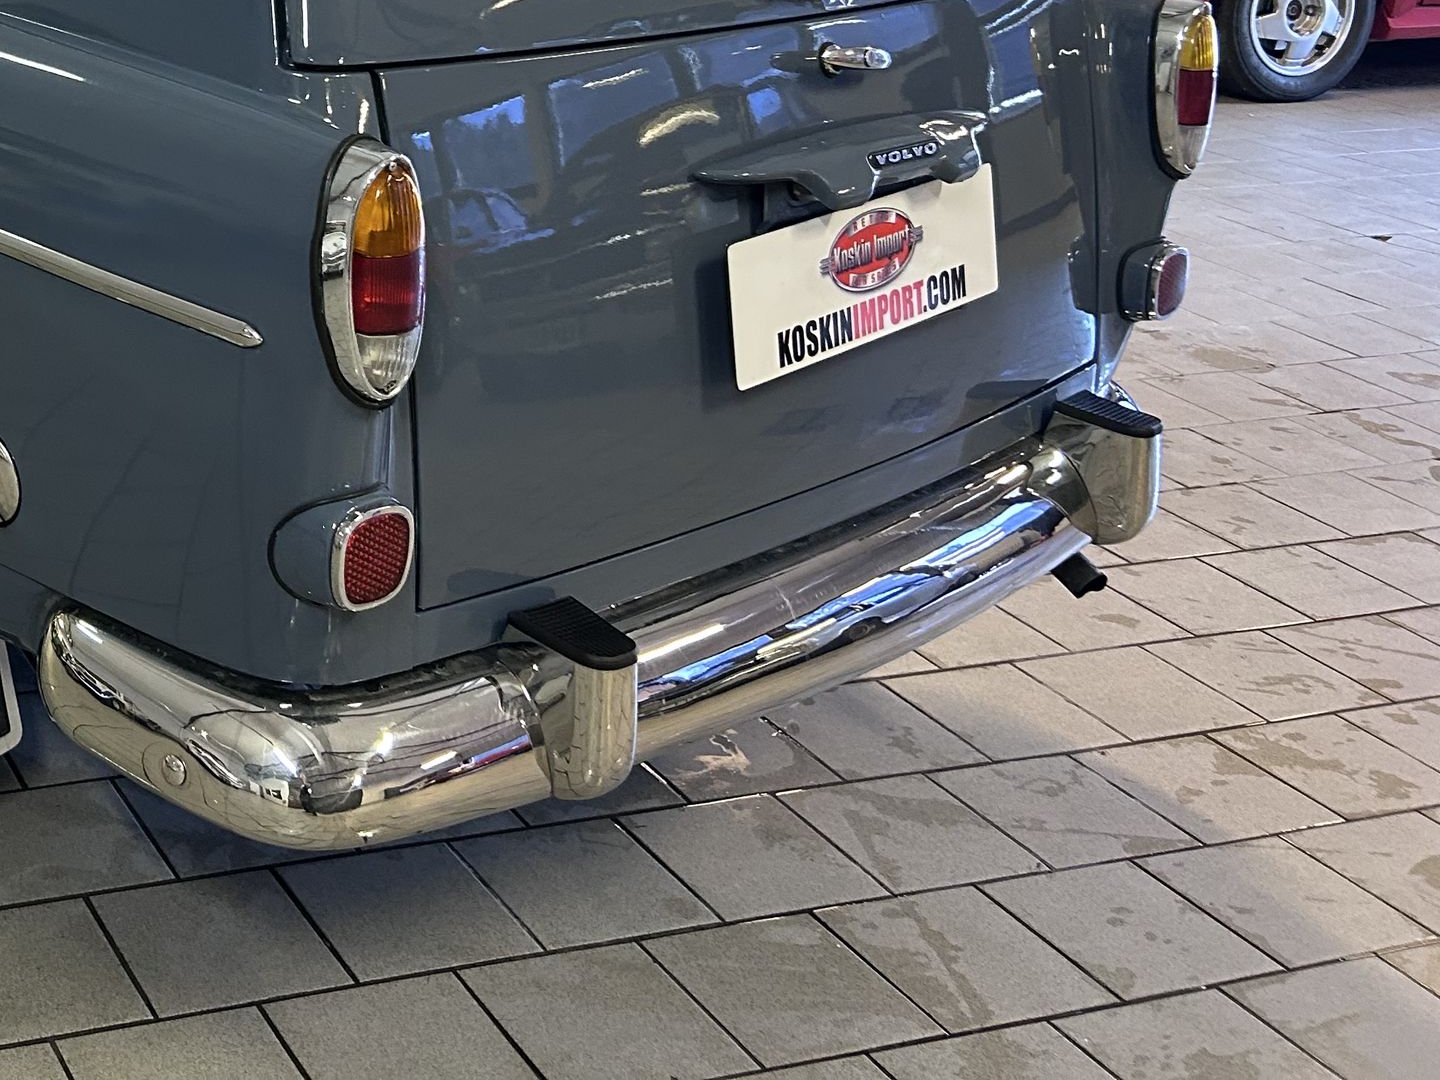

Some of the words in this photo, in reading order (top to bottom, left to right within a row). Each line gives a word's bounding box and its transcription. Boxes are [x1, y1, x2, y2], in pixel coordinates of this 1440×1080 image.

[875, 142, 937, 165] VOLVO
[833, 239, 872, 273] Koskin
[873, 224, 910, 259] Import
[777, 264, 967, 368] KOSKINIMPORT.COM
